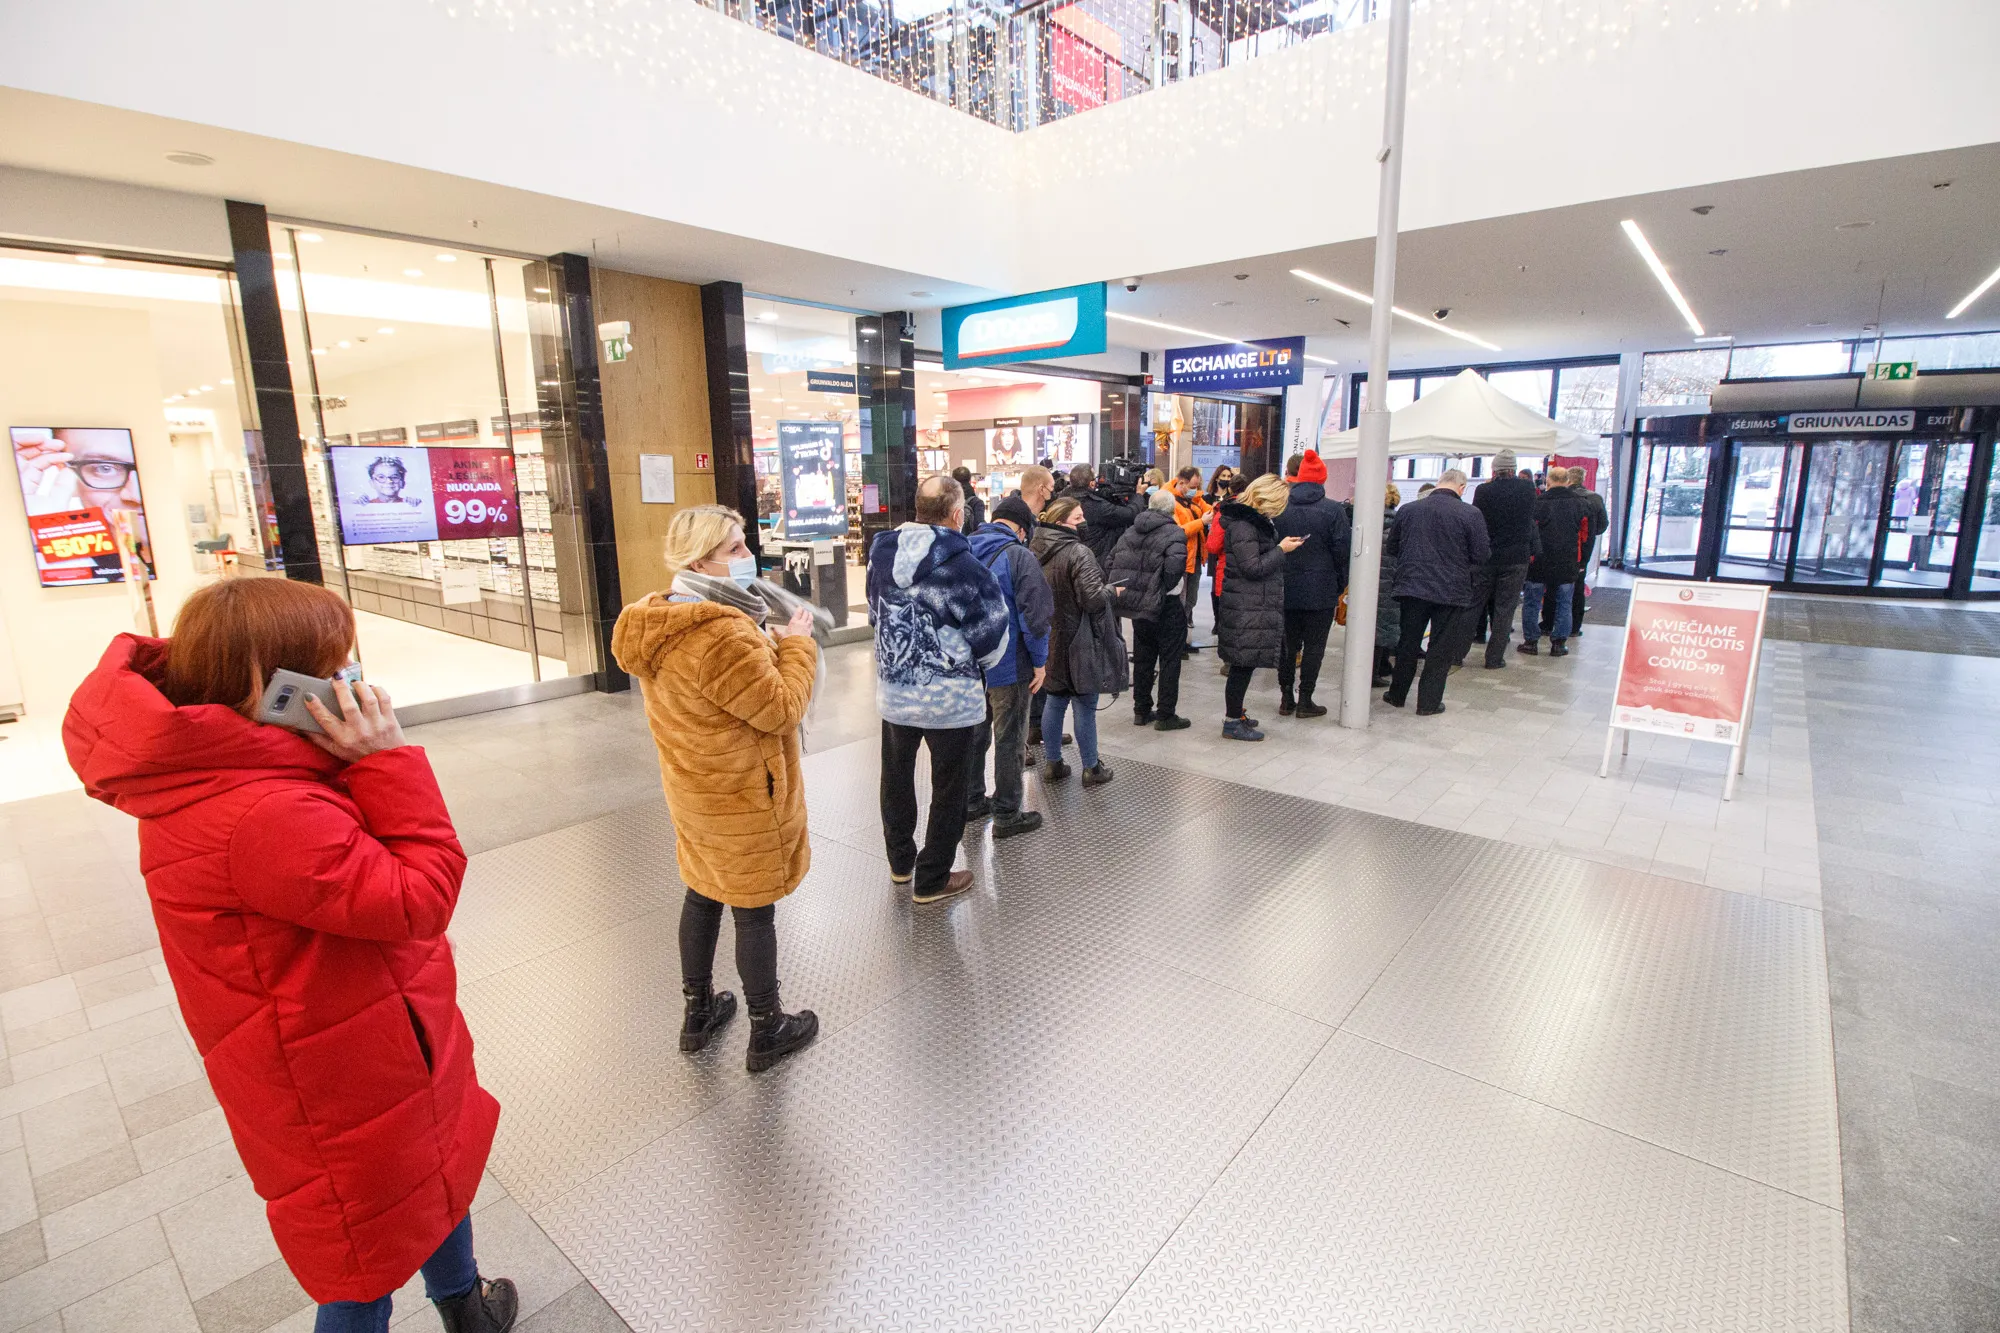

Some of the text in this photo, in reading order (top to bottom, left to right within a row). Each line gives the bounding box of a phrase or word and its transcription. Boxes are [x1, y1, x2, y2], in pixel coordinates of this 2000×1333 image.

[1172, 352, 1258, 374] EXCHANGE
[1172, 369, 1290, 383] VALIUTOS KEITYKLA
[1731, 415, 1955, 430] IŠĖJIMAS GRIUNVALDAS EXIT
[446, 482, 502, 492] NUOLAIDA
[1652, 618, 1738, 638] KVIEČIAME
[1640, 630, 1745, 652] VAKCINUOTIS
[1670, 646, 1707, 660] NUO
[1647, 656, 1725, 675] COVID-19!
